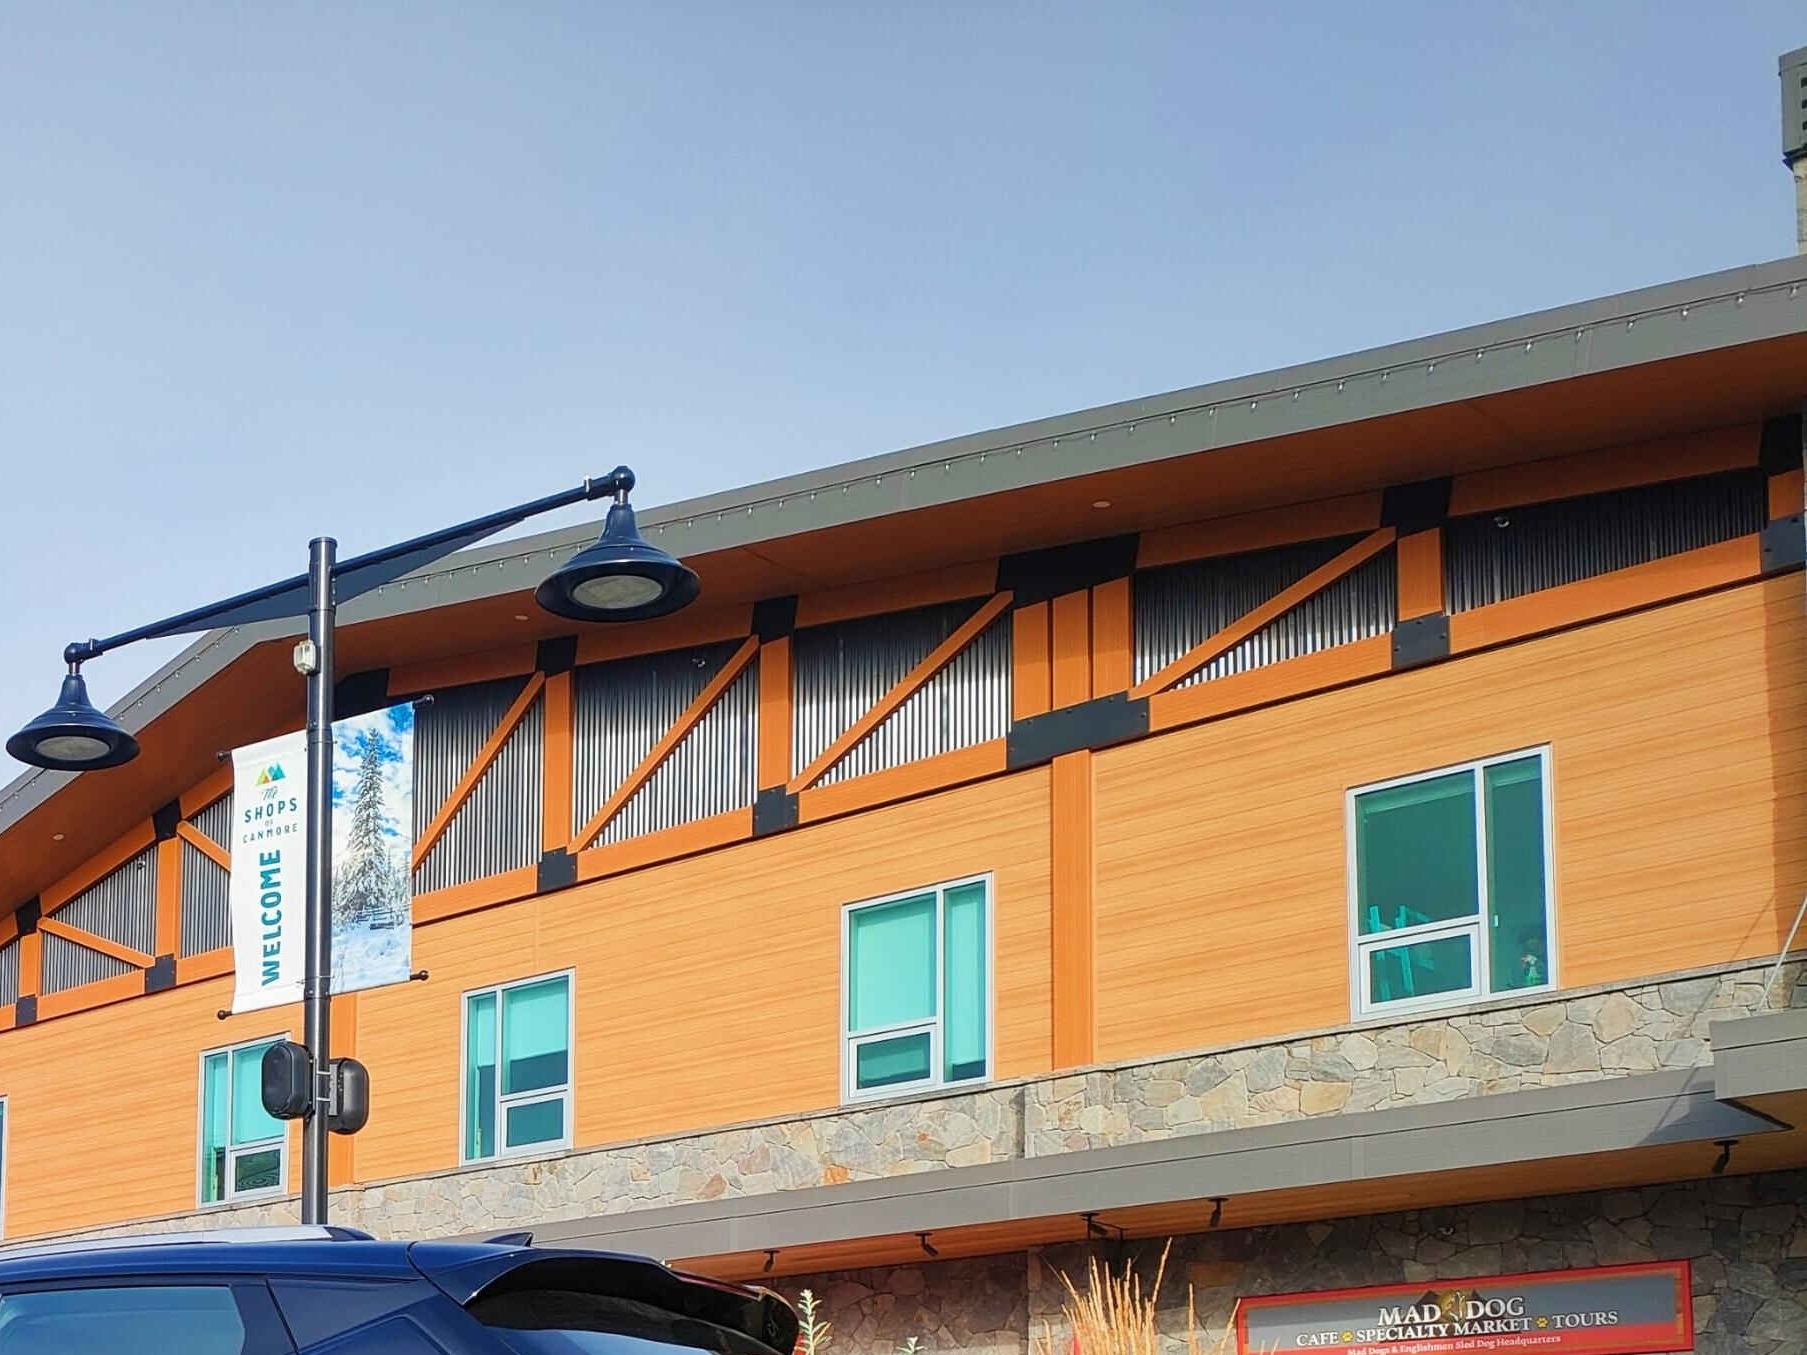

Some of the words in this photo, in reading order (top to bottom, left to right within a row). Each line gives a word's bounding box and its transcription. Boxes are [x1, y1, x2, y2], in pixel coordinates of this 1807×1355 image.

[244, 797, 297, 823] SHOPS
[243, 822, 298, 844] CANMORE
[259, 849, 282, 987] WELCOME
[1377, 1303, 1442, 1327] MAD
[1465, 1297, 1525, 1320] DOG
[1296, 1331, 1339, 1347] CAFE
[1356, 1323, 1451, 1343] SPECIALTY
[1454, 1317, 1532, 1336] MARKET
[1552, 1311, 1618, 1329] TOURS
[1400, 1342, 1454, 1355] Englishmen
[1455, 1340, 1475, 1350] Sled
[1476, 1339, 1495, 1350] Dog
[1496, 1335, 1561, 1348] Headquarters
